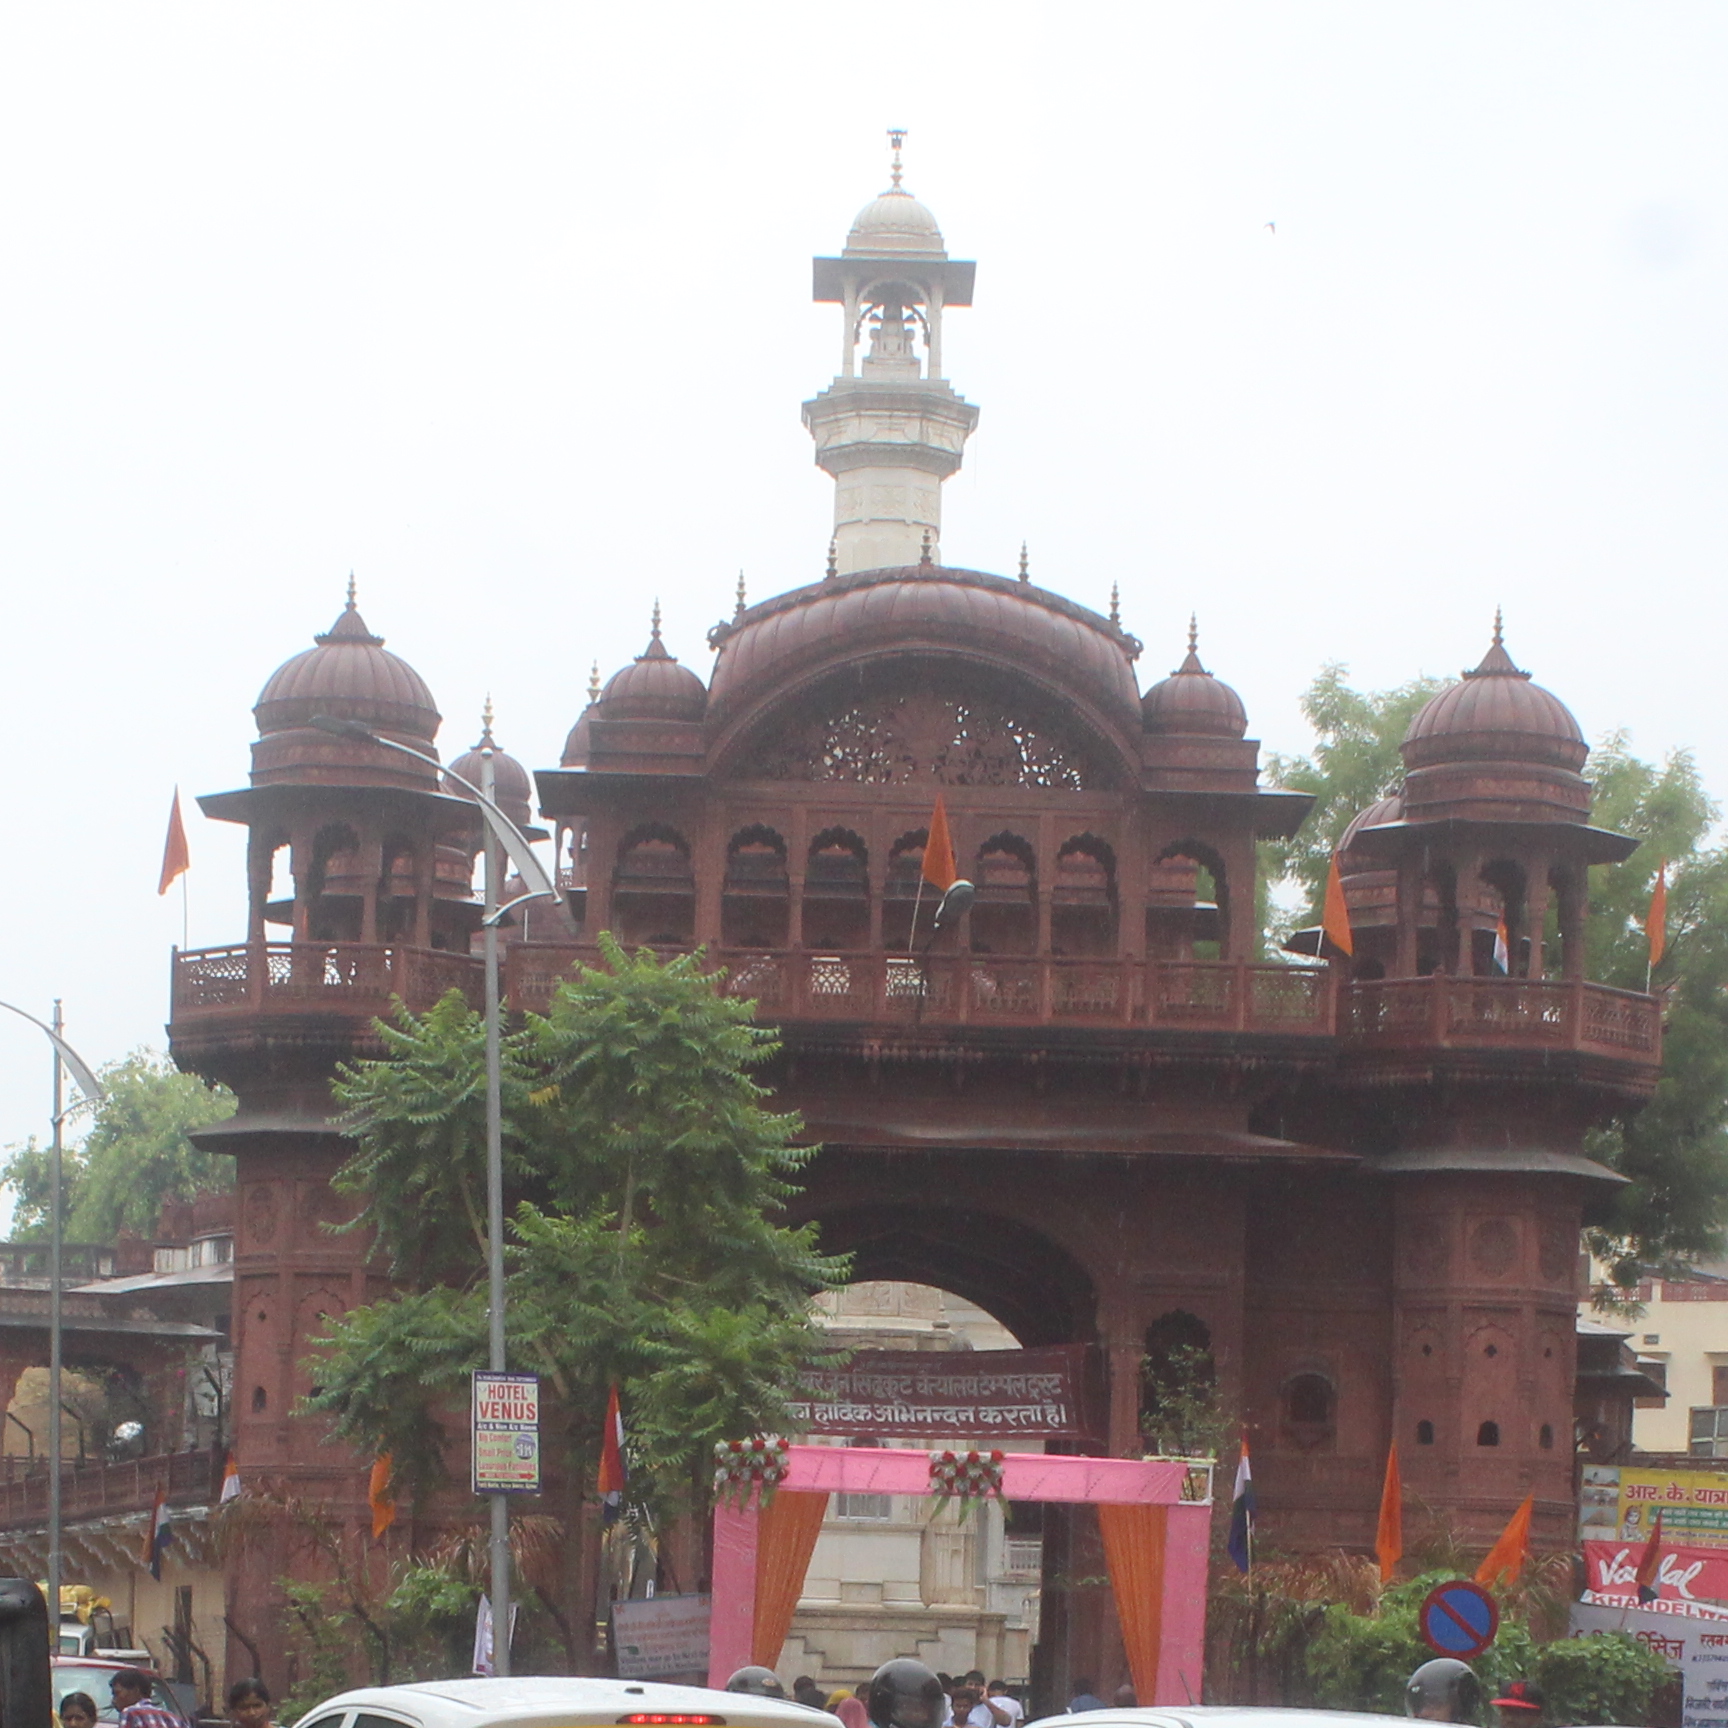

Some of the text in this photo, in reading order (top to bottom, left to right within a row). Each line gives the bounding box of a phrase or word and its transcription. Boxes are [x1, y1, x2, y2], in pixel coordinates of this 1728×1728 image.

[488, 1384, 528, 1400] HOTEL
[479, 1402, 536, 1420] VENUS
[873, 1400, 975, 1426] अभिनन्दन
[978, 1404, 1042, 1427] करता
